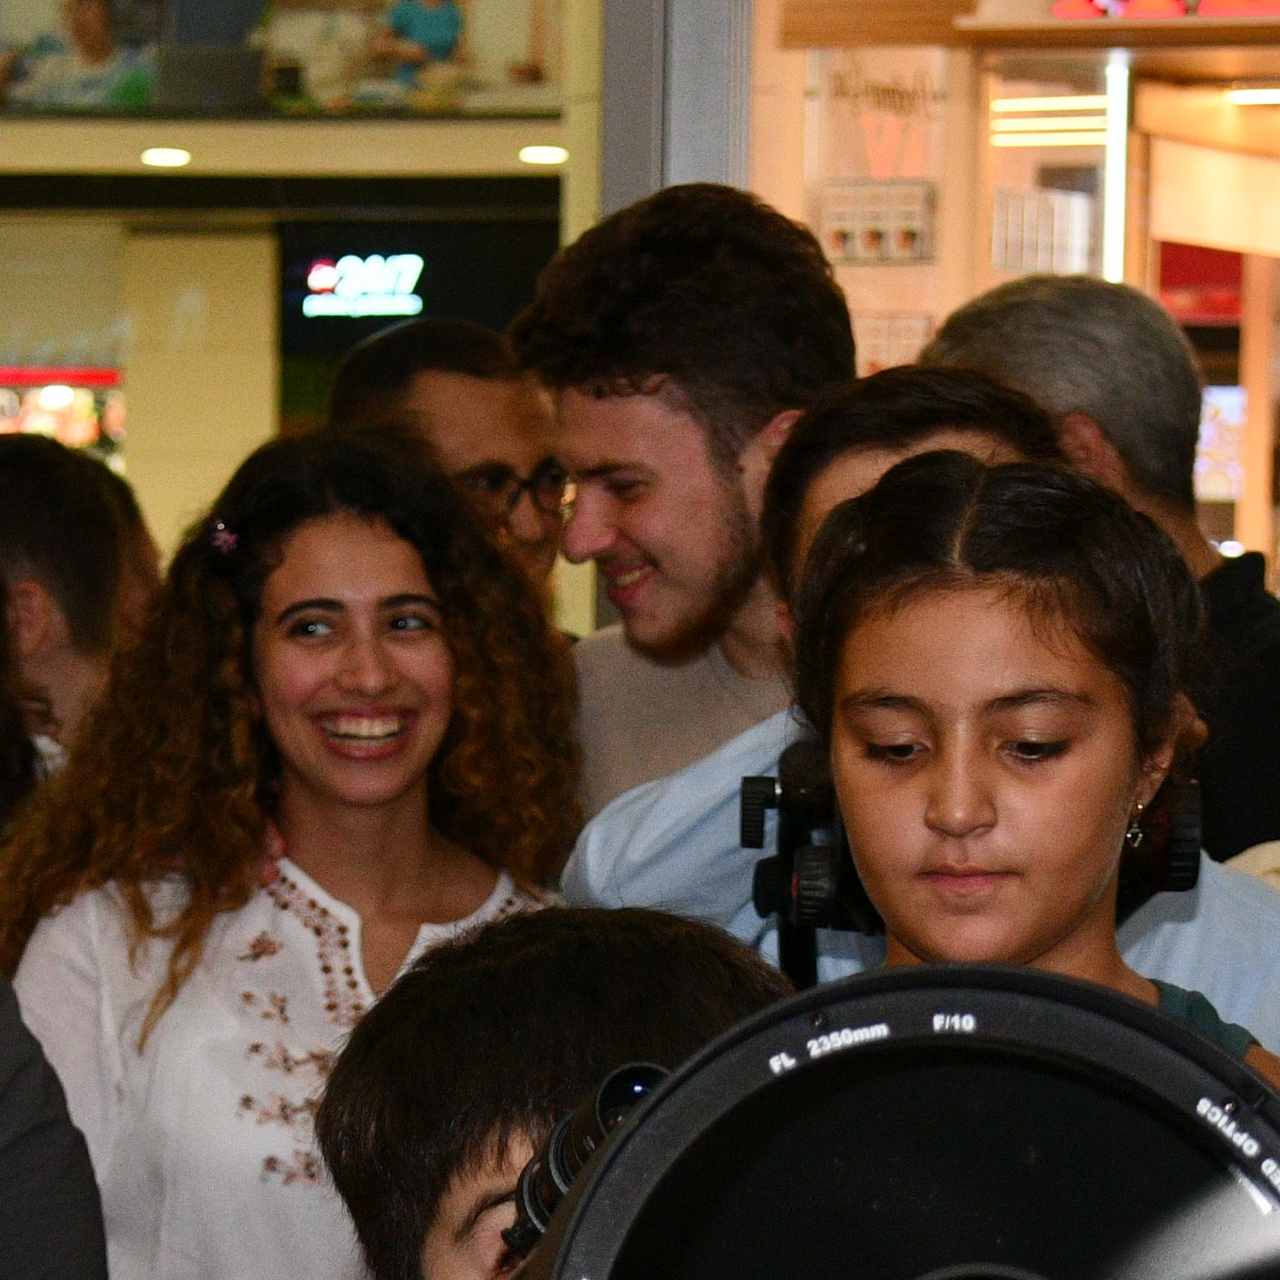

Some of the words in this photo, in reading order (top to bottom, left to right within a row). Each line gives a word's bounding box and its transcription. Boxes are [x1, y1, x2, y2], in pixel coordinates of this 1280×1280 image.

[768, 1051, 796, 1075] FL
[806, 1021, 890, 1058] 2350mm
[932, 1013, 976, 1033] F/10
[1196, 1097, 1260, 1157] OPTICS
